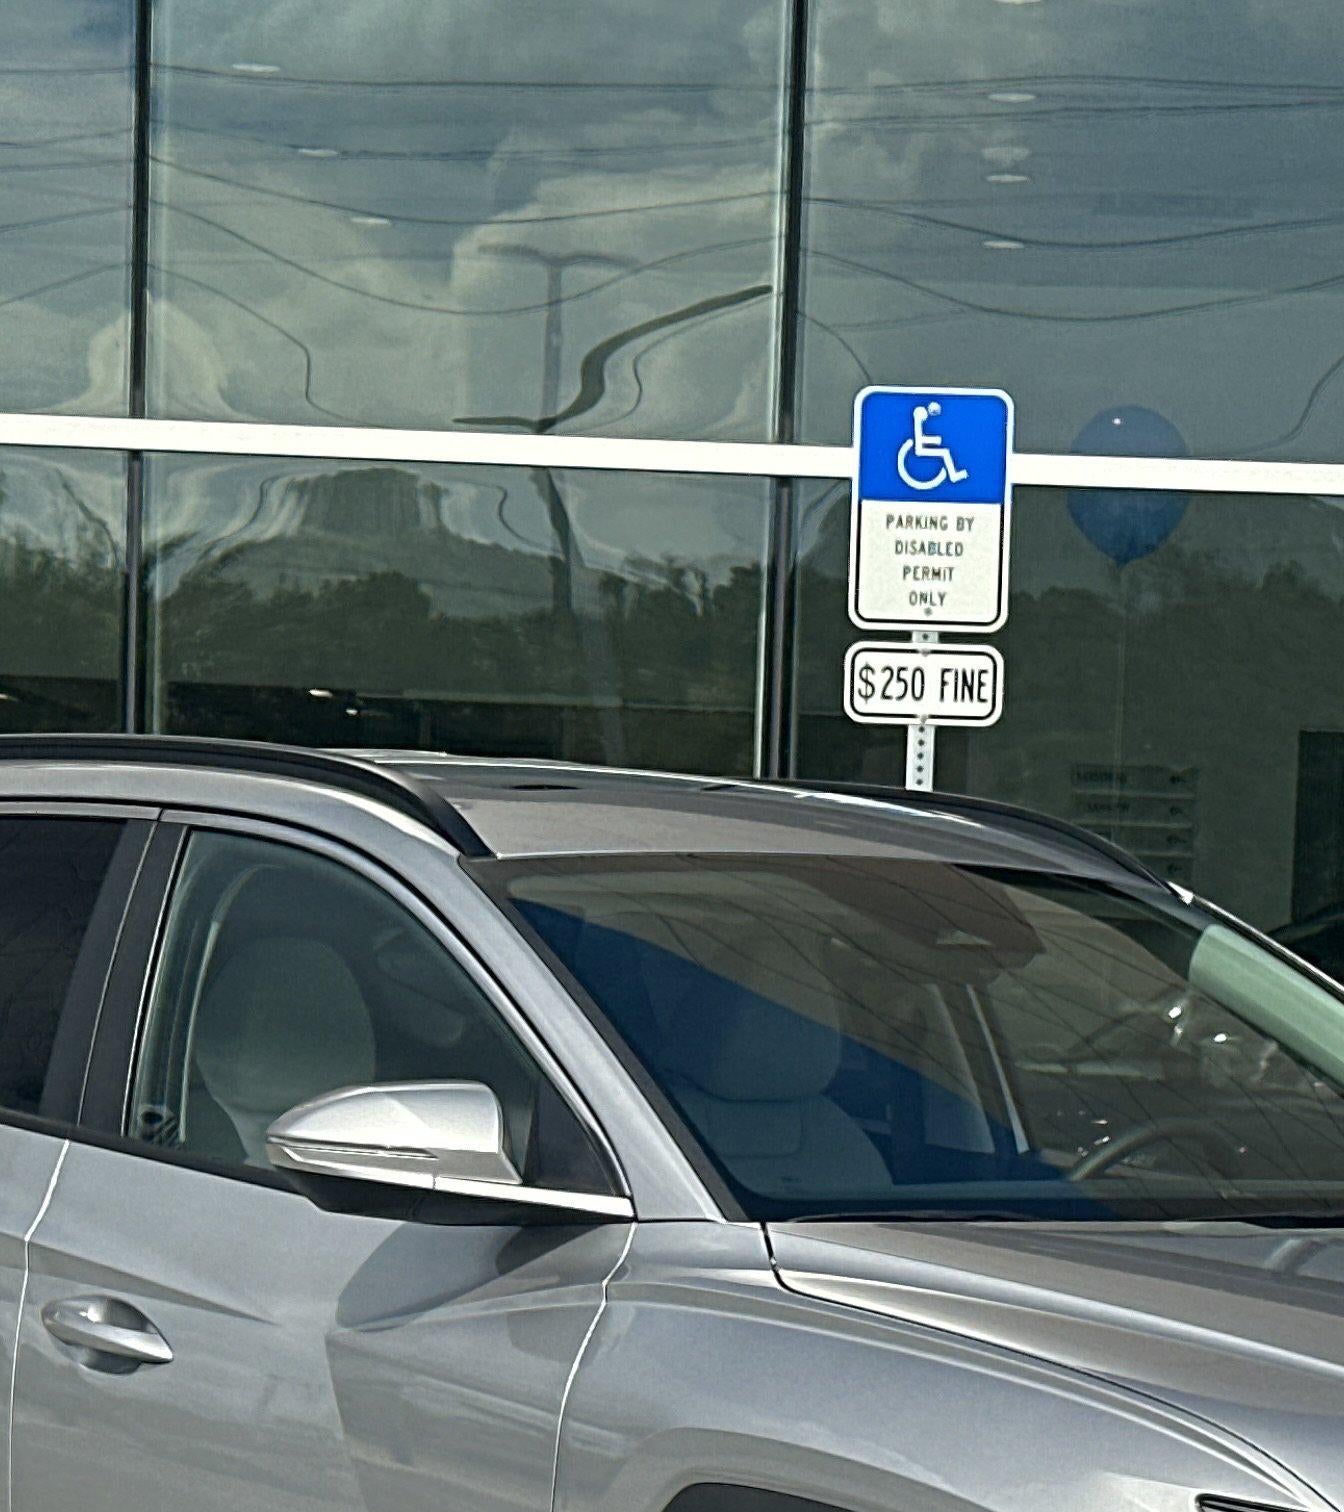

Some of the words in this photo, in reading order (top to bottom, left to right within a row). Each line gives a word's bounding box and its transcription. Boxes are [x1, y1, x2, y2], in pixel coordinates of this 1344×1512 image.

[886, 513, 949, 531] PARKING
[956, 515, 975, 532] BY
[895, 539, 964, 557] DISABLED
[902, 564, 956, 582] PERMIT
[908, 589, 948, 607] ONLY
[857, 661, 926, 704] $250
[939, 666, 989, 704] FINE
